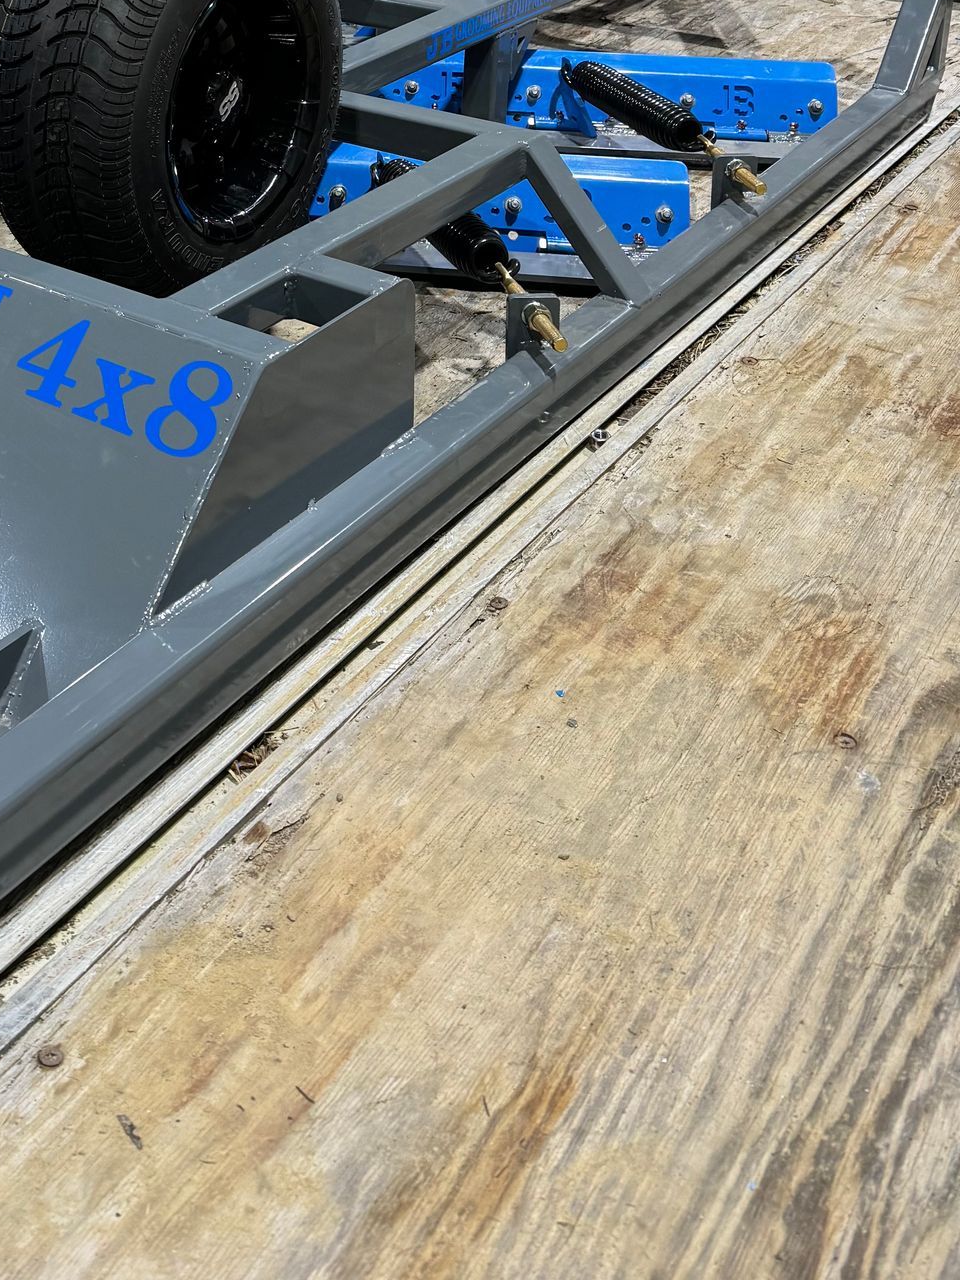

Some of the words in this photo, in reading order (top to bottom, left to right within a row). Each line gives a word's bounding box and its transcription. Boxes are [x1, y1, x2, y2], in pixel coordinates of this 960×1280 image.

[425, 26, 453, 61] JB
[455, 3, 505, 41] GROOMING
[712, 84, 755, 117] JB
[16, 319, 233, 458] 4x8
